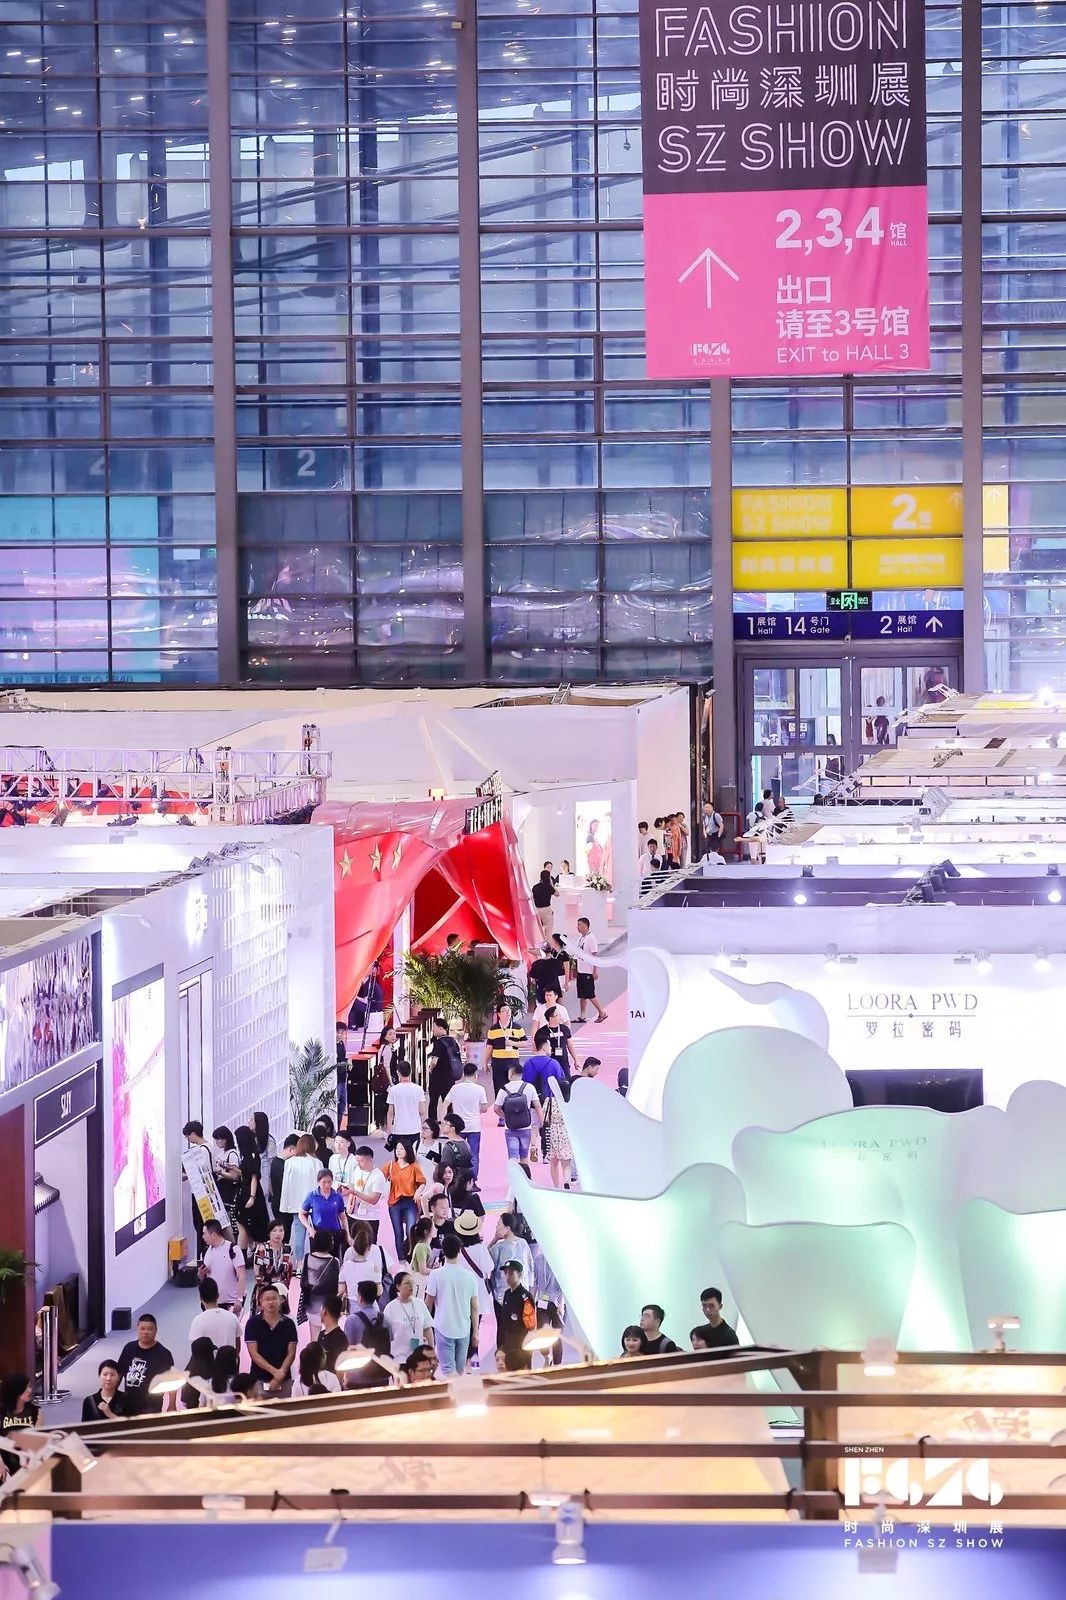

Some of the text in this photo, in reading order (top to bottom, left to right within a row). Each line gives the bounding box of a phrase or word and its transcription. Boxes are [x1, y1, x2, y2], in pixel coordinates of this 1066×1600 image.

[655, 0, 907, 57] FASHION
[656, 62, 911, 112] 时尚深圳展
[657, 118, 911, 173] SZ SHOW
[775, 206, 907, 256] 2,3,4 馆
[776, 275, 832, 304] 出口
[776, 306, 910, 339] 请至3号馆
[776, 343, 909, 363] EXIT to HALL 3
[297, 449, 316, 477] 2
[891, 493, 918, 529] 2
[747, 616, 829, 635] 1 展馆 14 号门
[757, 626, 831, 635] Hall Gate
[880, 615, 917, 634] 2 展馆
[847, 992, 978, 1010] LOORA PWD
[866, 1020, 962, 1038] 罗拉密码
